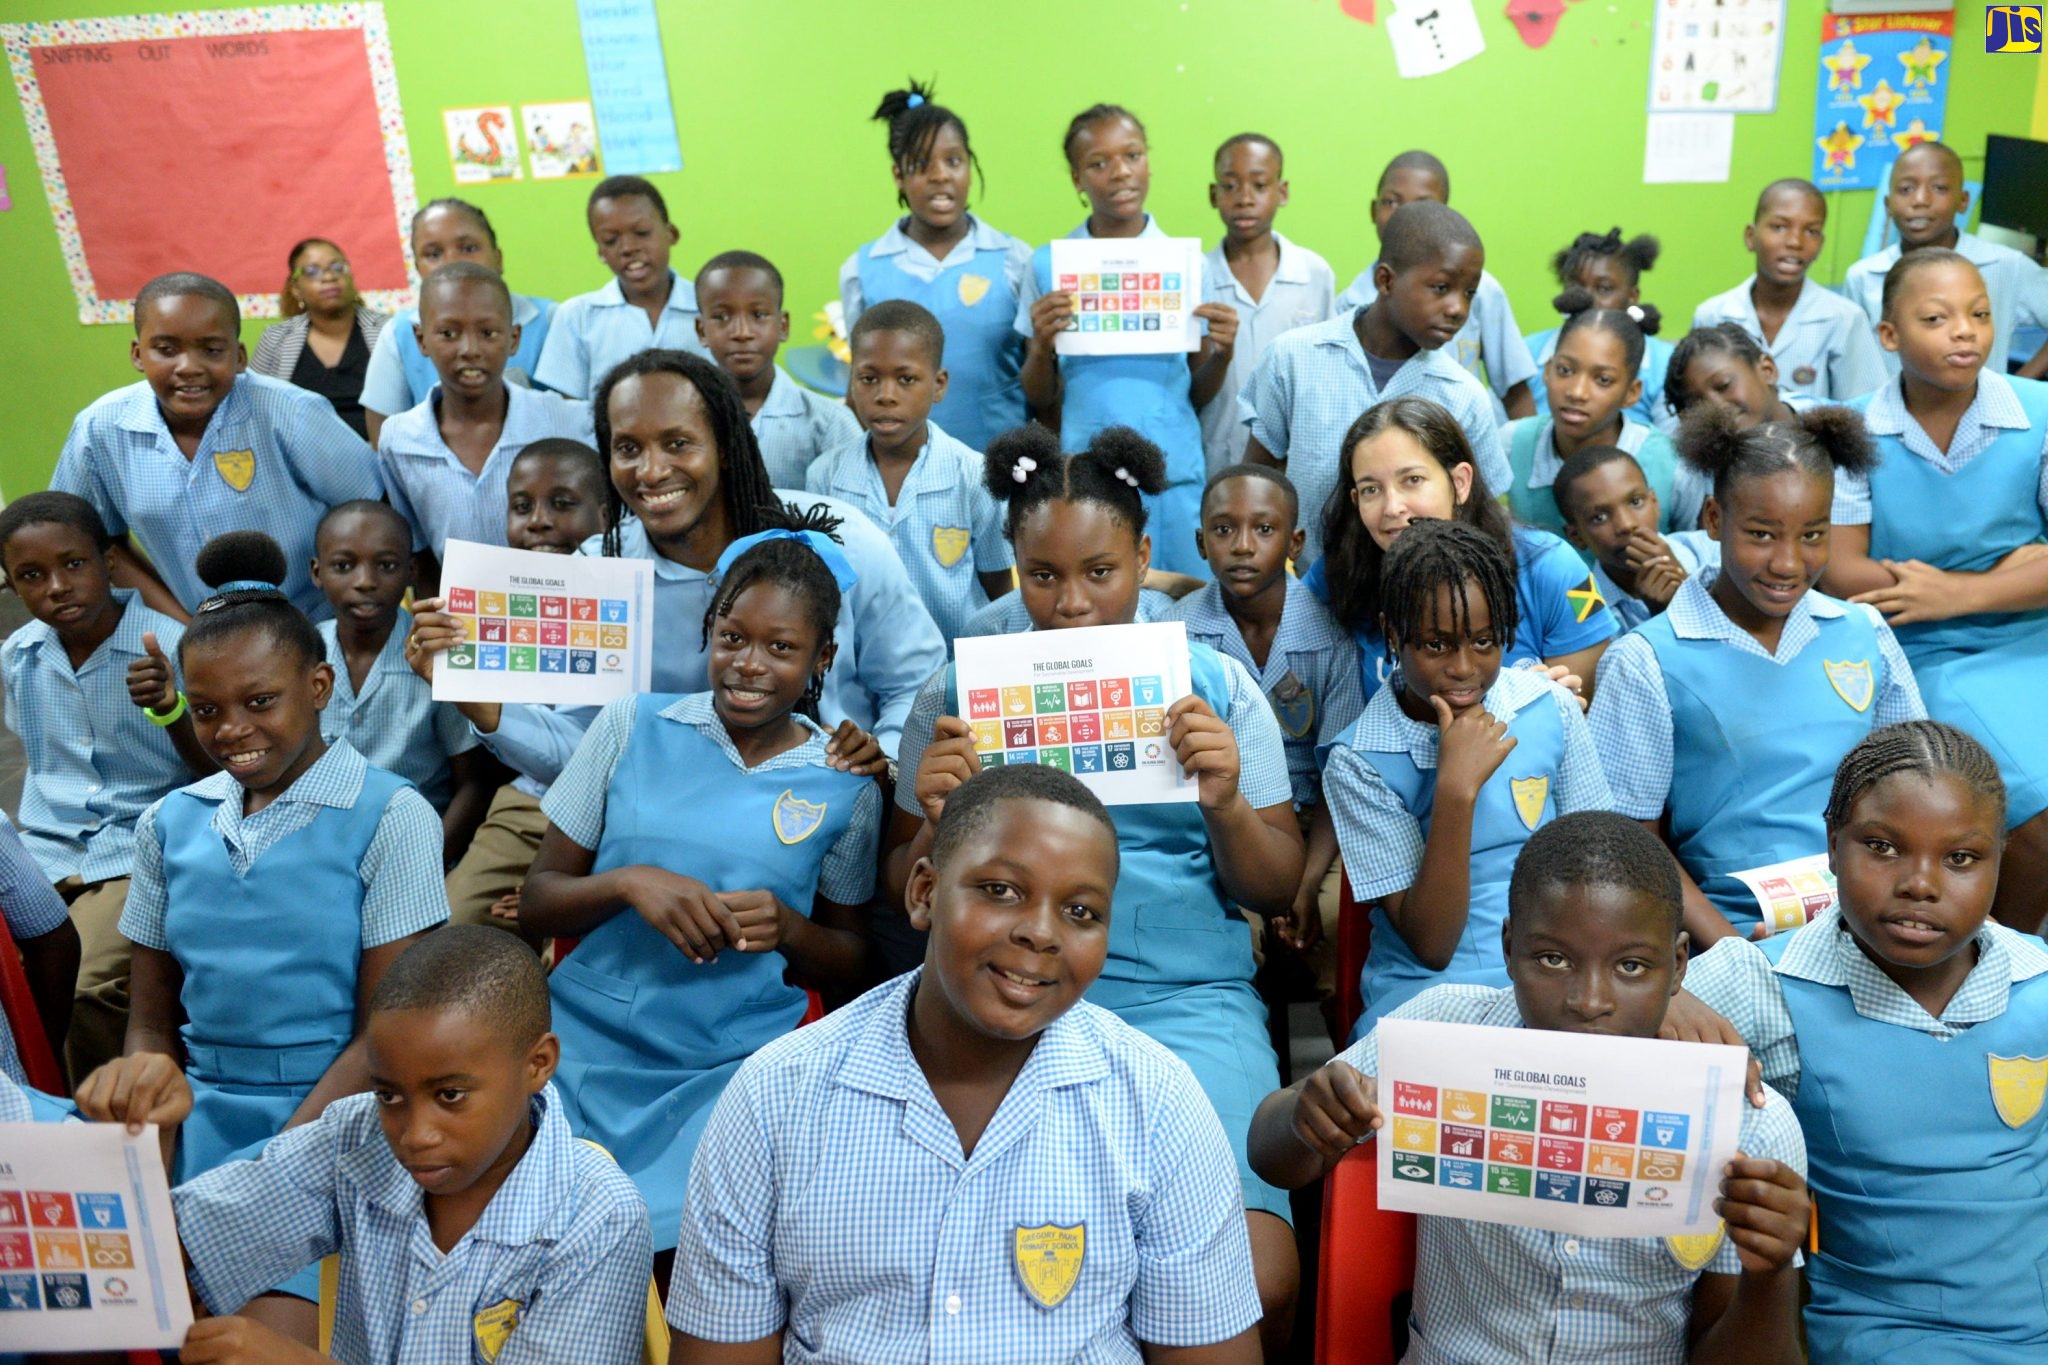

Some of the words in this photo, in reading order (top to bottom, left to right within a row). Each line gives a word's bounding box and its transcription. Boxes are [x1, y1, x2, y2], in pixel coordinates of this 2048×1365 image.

[42, 47, 112, 65] SNIFFING
[138, 45, 172, 62] OUT
[205, 39, 269, 59] WORDS
[1033, 662, 1045, 672] THE
[1046, 660, 1070, 671] GLOBAL
[1071, 658, 1093, 669] GOALS
[1494, 1068, 1513, 1081] THE
[1514, 1070, 1551, 1085] GLOBAL
[1553, 1074, 1586, 1088] GOALS
[1545, 1103, 1552, 1112] 4
[1541, 1139, 1551, 1148] 10
[1394, 1152, 1404, 1160] 13
[1442, 1160, 1451, 1168] 14
[1490, 1166, 1500, 1174] 15
[1589, 1179, 1598, 1187] 17
[1051, 1242, 1079, 1250] SCHOOL
